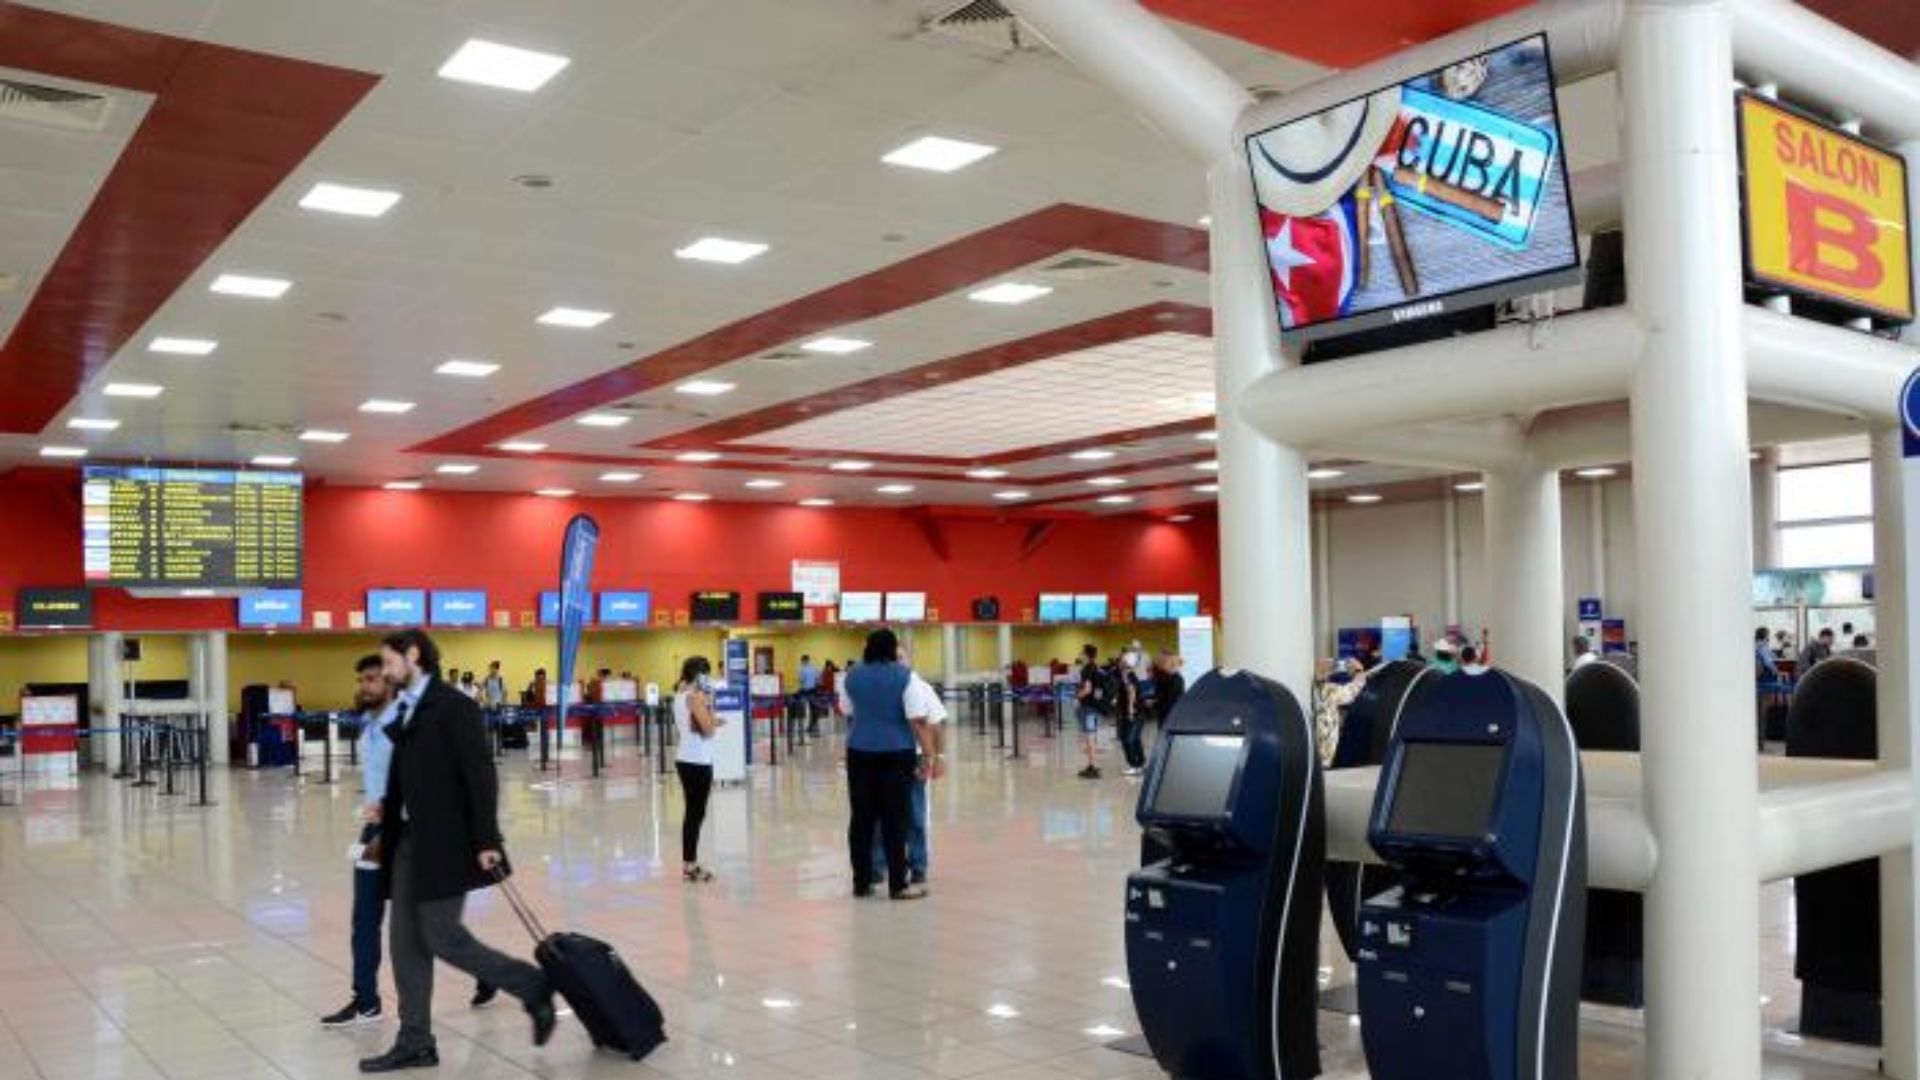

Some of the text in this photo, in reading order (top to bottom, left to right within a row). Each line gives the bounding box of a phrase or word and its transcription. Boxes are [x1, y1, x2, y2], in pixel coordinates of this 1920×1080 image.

[1398, 115, 1523, 217] CUBA
[1774, 120, 1880, 198] SALON
[1785, 177, 1885, 290] B
